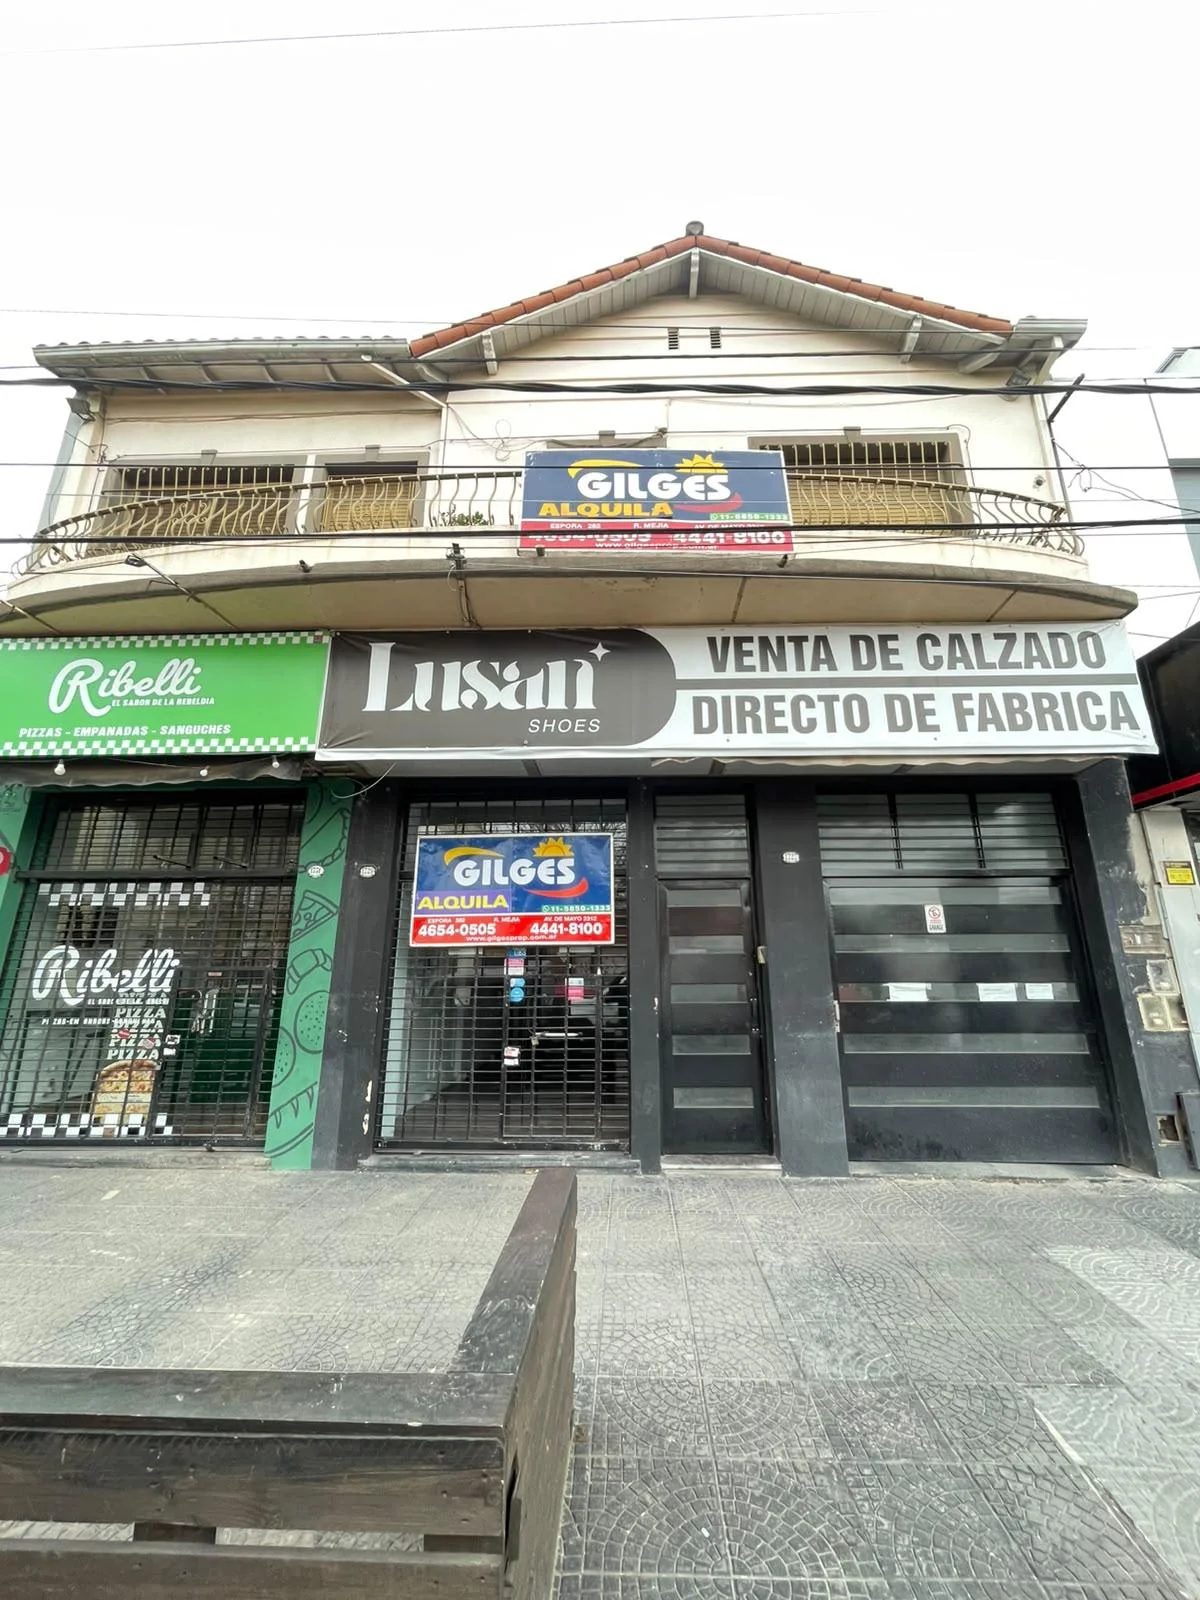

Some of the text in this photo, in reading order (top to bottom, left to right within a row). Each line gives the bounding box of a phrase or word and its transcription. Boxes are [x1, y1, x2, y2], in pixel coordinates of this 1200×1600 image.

[577, 472, 731, 501] GILGES
[539, 502, 673, 517] ALQUILA
[707, 632, 1107, 673] VENTA DE CALZADO
[48, 658, 202, 717] Ribelli
[111, 697, 215, 707] EL SABOR DE LA REBELDIA
[692, 690, 1141, 735] DIRECTO DE FABRICA
[19, 727, 63, 738] PIZZAS
[73, 725, 149, 737] EMPANADAS
[160, 724, 231, 736] SANGUCHES
[528, 718, 601, 733] SHOES
[454, 858, 575, 886] GILGES
[417, 894, 509, 910] ALQUILA
[418, 922, 603, 937] 4654-0505 4441-8100
[32, 945, 181, 1006] Ribelli
[115, 1006, 167, 1019] PIZZA
[106, 1049, 160, 1060] PIZZA
